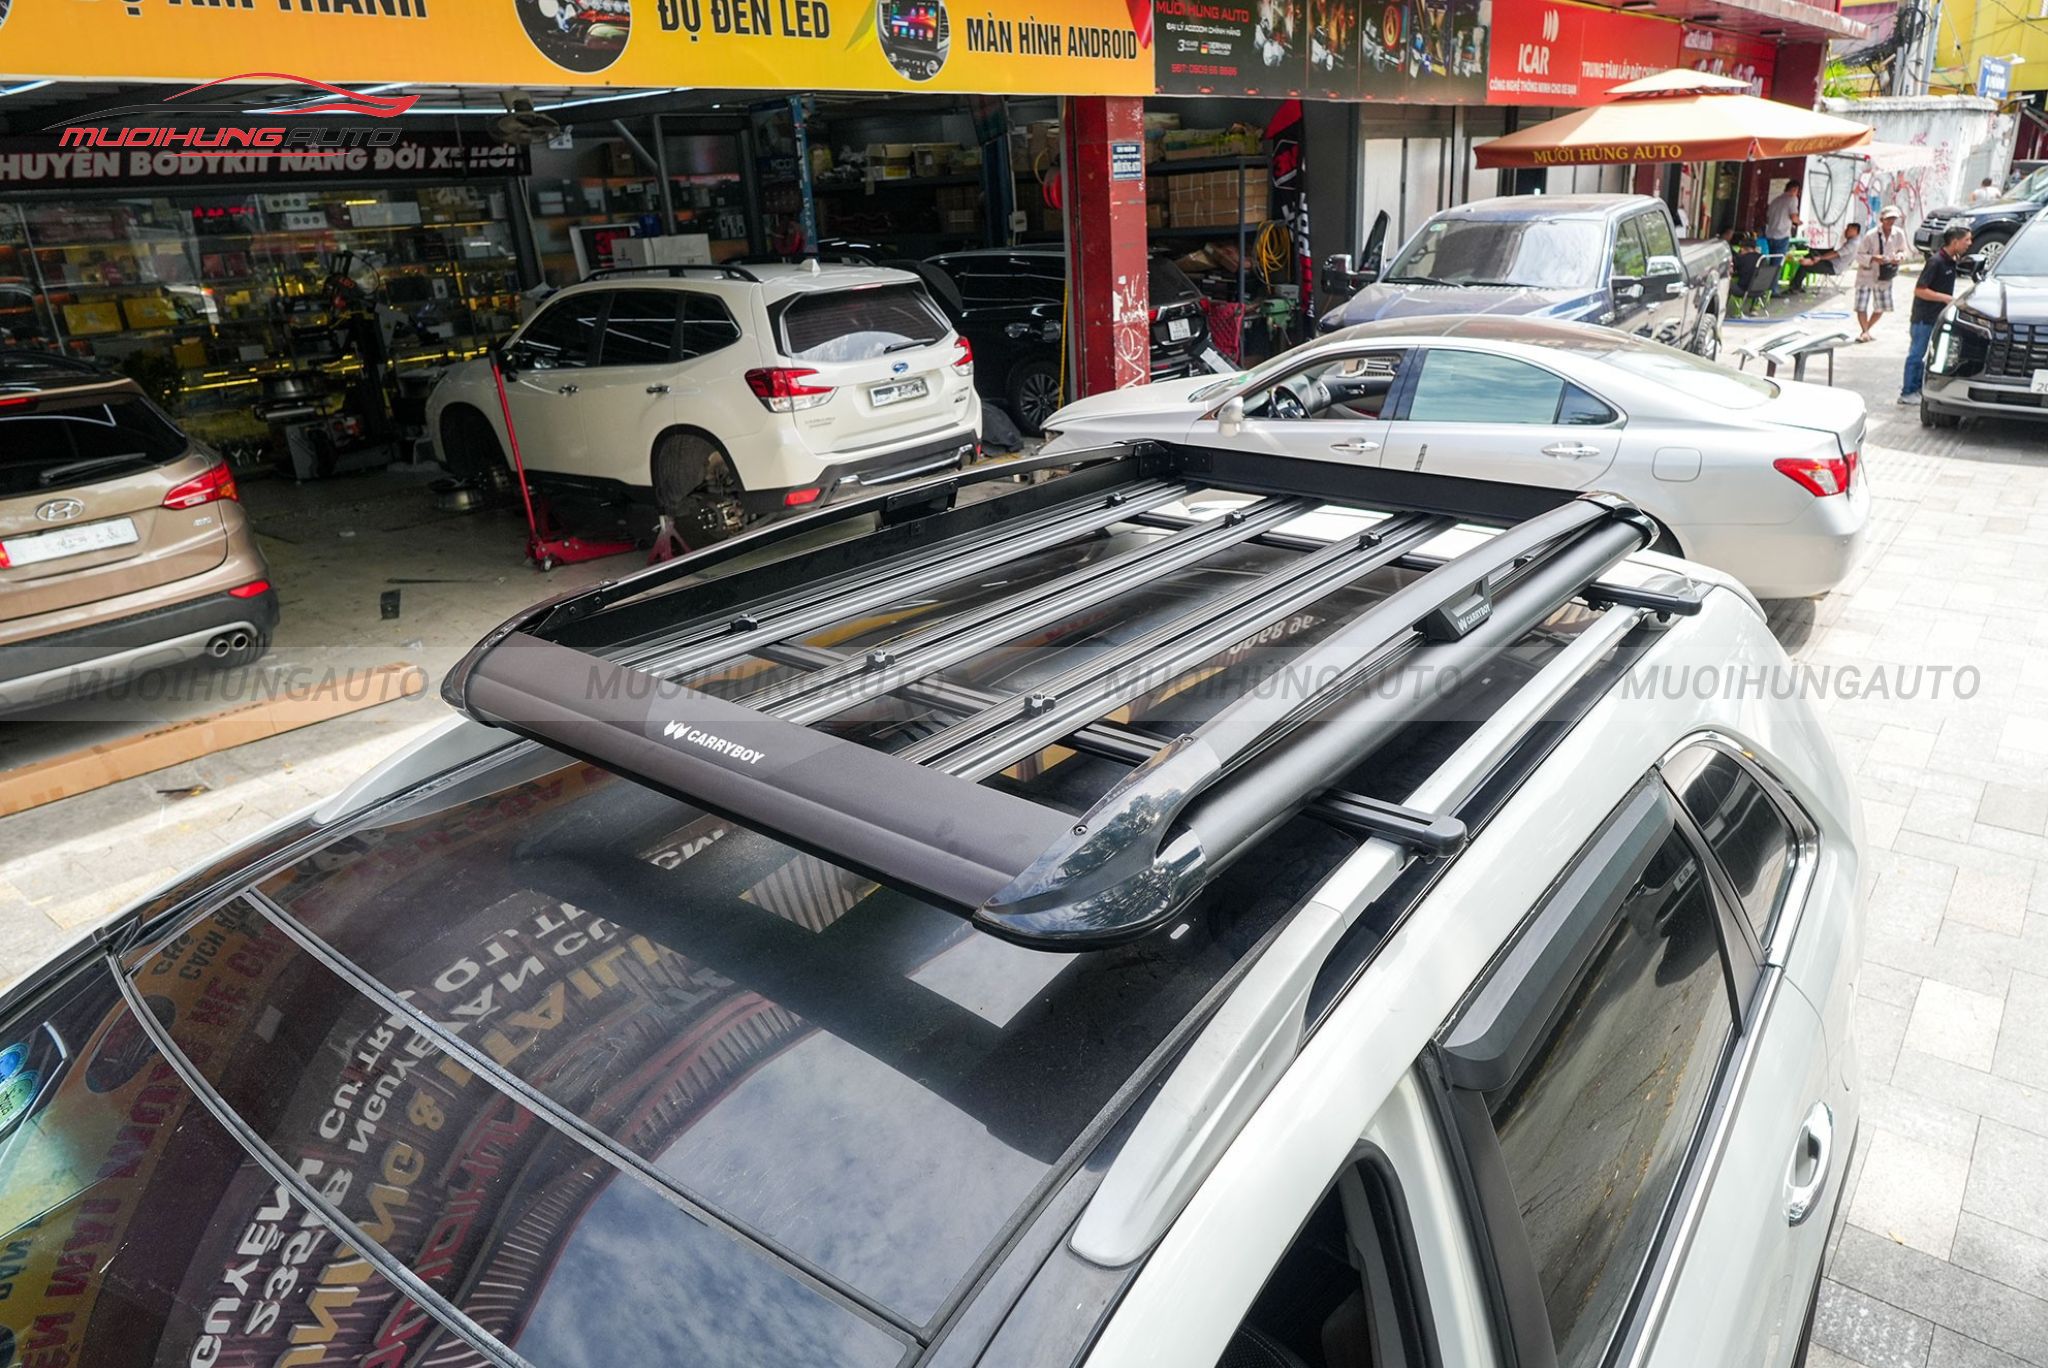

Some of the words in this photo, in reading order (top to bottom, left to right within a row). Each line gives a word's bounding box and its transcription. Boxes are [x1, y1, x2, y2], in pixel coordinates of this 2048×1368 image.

[780, 0, 830, 39] LED
[1221, 7, 1250, 24] AUTO
[966, 12, 1013, 54] MÀN
[1018, 16, 1062, 56] HÌNH
[1067, 26, 1137, 60] ANDROID
[1177, 39, 1185, 52] 3
[1517, 43, 1550, 76] ICAR
[128, 148, 268, 177] BODYKIT
[1579, 143, 1629, 161] HÙNG
[1632, 144, 1682, 160] AUTO
[687, 729, 765, 765] CARRYBOY
